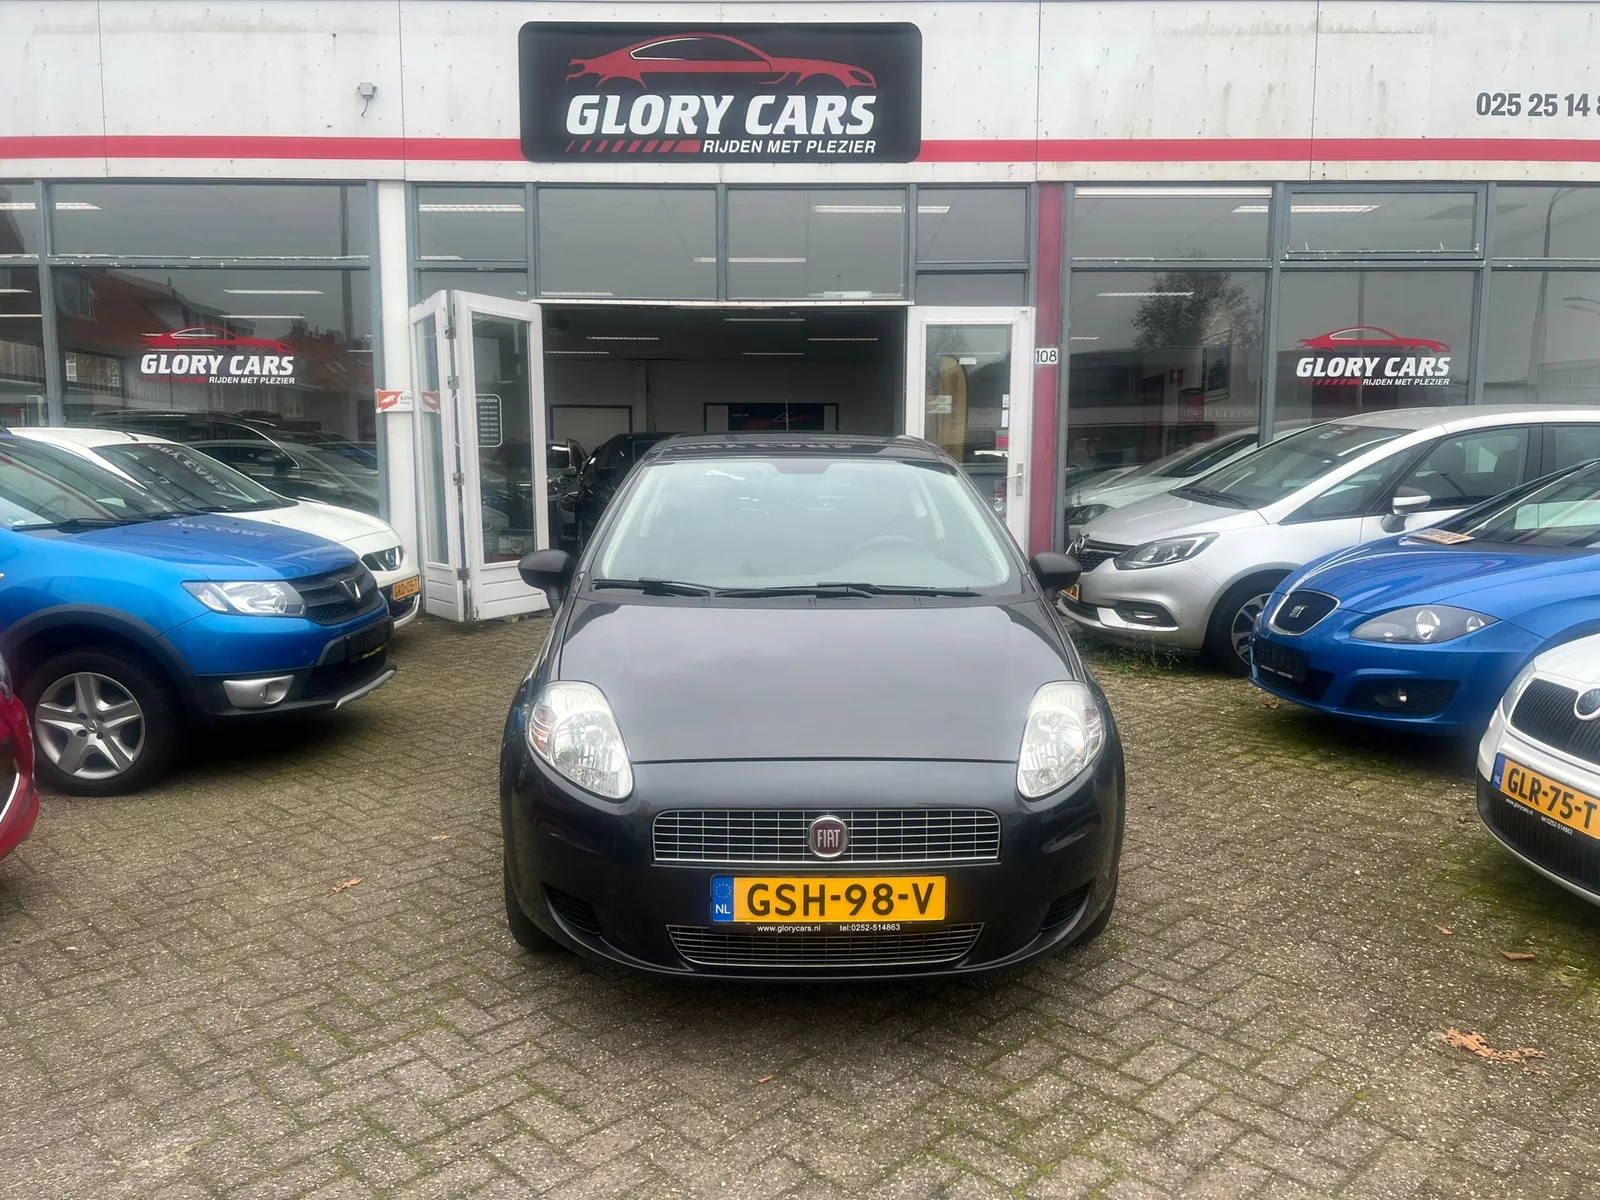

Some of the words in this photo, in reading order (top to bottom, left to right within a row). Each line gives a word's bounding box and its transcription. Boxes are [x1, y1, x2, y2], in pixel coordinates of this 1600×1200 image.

[1476, 92, 1521, 117] 025
[1527, 93, 1558, 117] 25
[1564, 93, 1590, 117] 14
[566, 94, 734, 135] GLORY
[745, 94, 877, 135] CARS
[703, 139, 763, 154] RIJDEN
[767, 140, 802, 154] MET
[805, 139, 877, 154] PLEZIER
[140, 354, 224, 375] GLORY
[229, 355, 295, 375] CARS
[1036, 350, 1057, 362] 108
[1296, 357, 1381, 378] GLORY
[1384, 357, 1451, 378] CARS
[208, 376, 239, 384] RIJDEN
[240, 376, 258, 384] MET
[259, 376, 295, 385] PLEZIER
[1362, 378, 1394, 386] RIJDEN
[1394, 378, 1412, 386] MET
[1413, 378, 1450, 386] PLEZIER
[1507, 767, 1598, 829] GLR-75-T
[817, 829, 841, 848] FIAT
[715, 904, 731, 915] NL
[747, 883, 935, 917] GSH-98-V
[757, 924, 821, 932] www.glorycars.nl
[839, 923, 901, 932] tel:0252-514863
